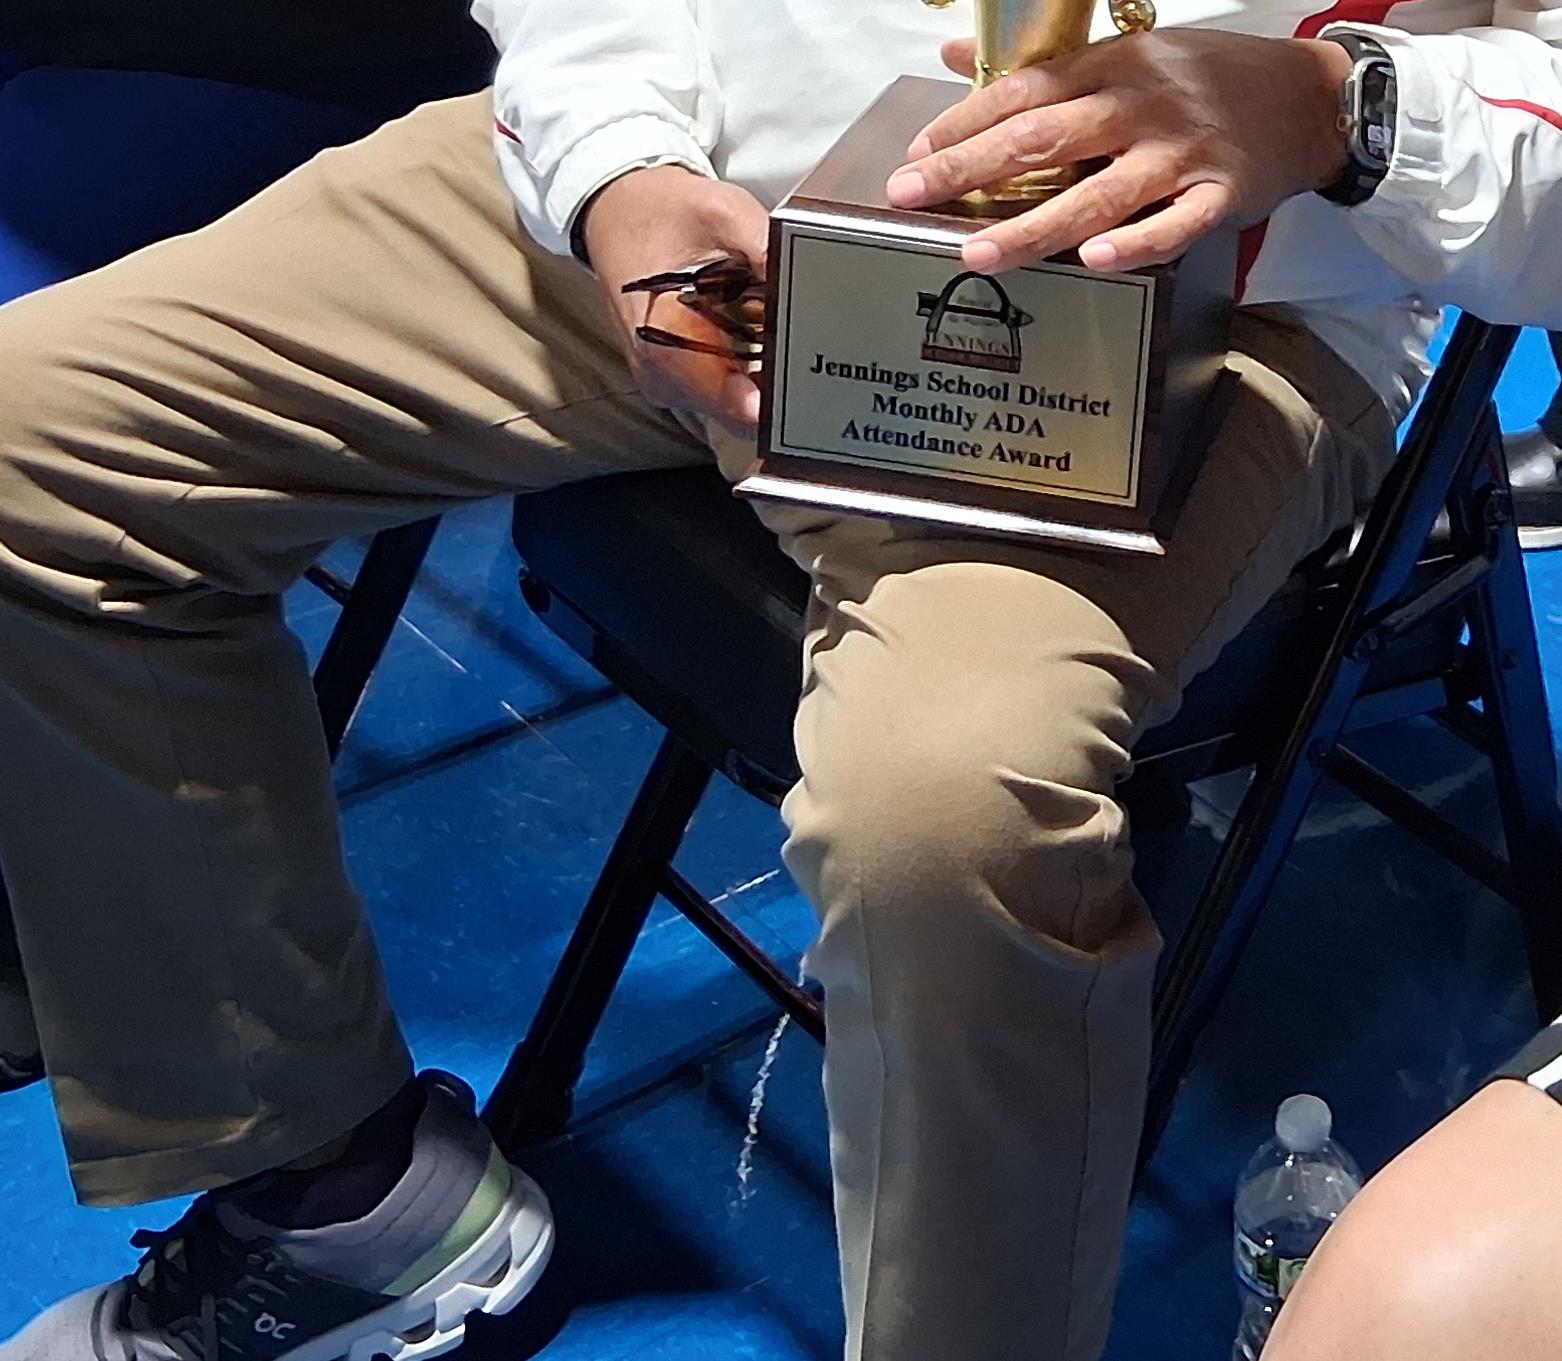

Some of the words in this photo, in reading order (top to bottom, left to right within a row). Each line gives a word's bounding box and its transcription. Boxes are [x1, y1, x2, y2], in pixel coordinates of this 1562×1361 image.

[810, 353, 920, 393] Jennings
[927, 371, 1010, 403] School
[1018, 384, 1112, 418] District
[872, 393, 978, 432] Monthly
[983, 411, 1047, 439] ADA
[841, 419, 984, 459] Attendance
[988, 442, 1072, 472] Award
